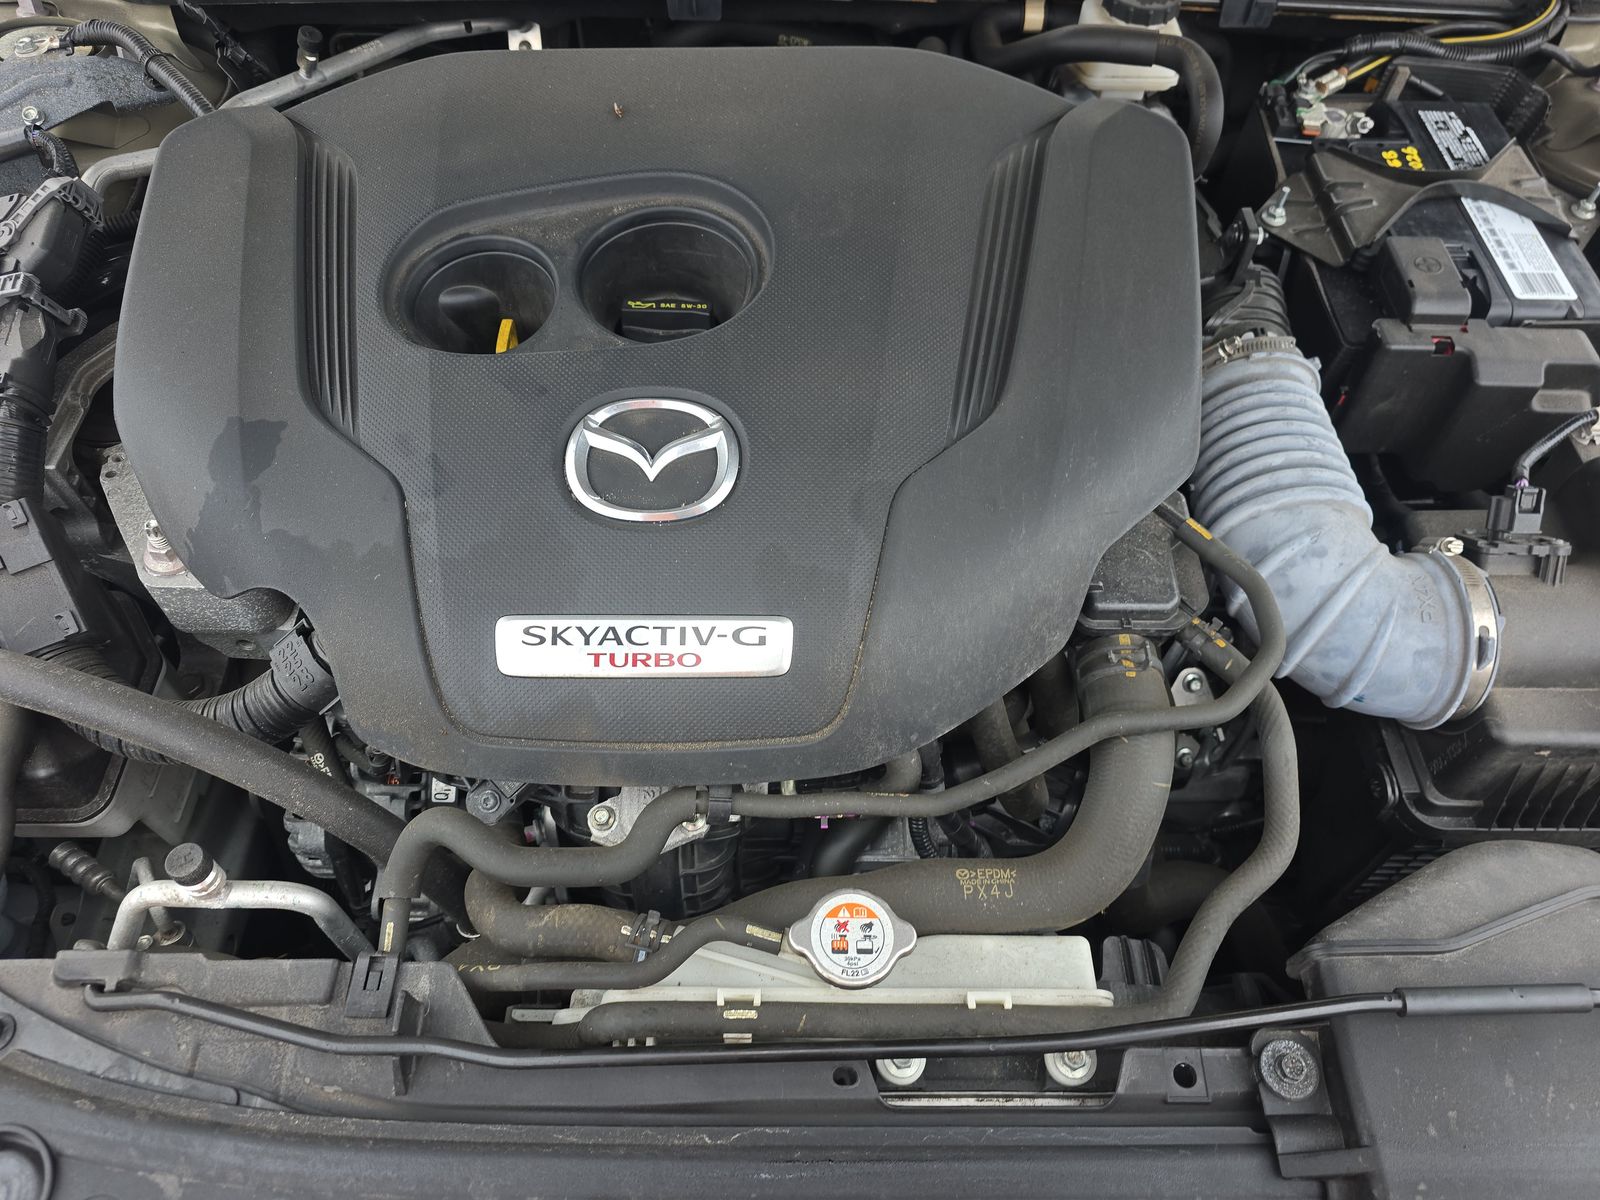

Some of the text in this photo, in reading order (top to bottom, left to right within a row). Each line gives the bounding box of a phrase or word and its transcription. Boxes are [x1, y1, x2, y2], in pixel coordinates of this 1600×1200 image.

[521, 625, 767, 646] SKYACTIV-G
[587, 652, 702, 668] TURBO
[841, 968, 860, 977] FL22
